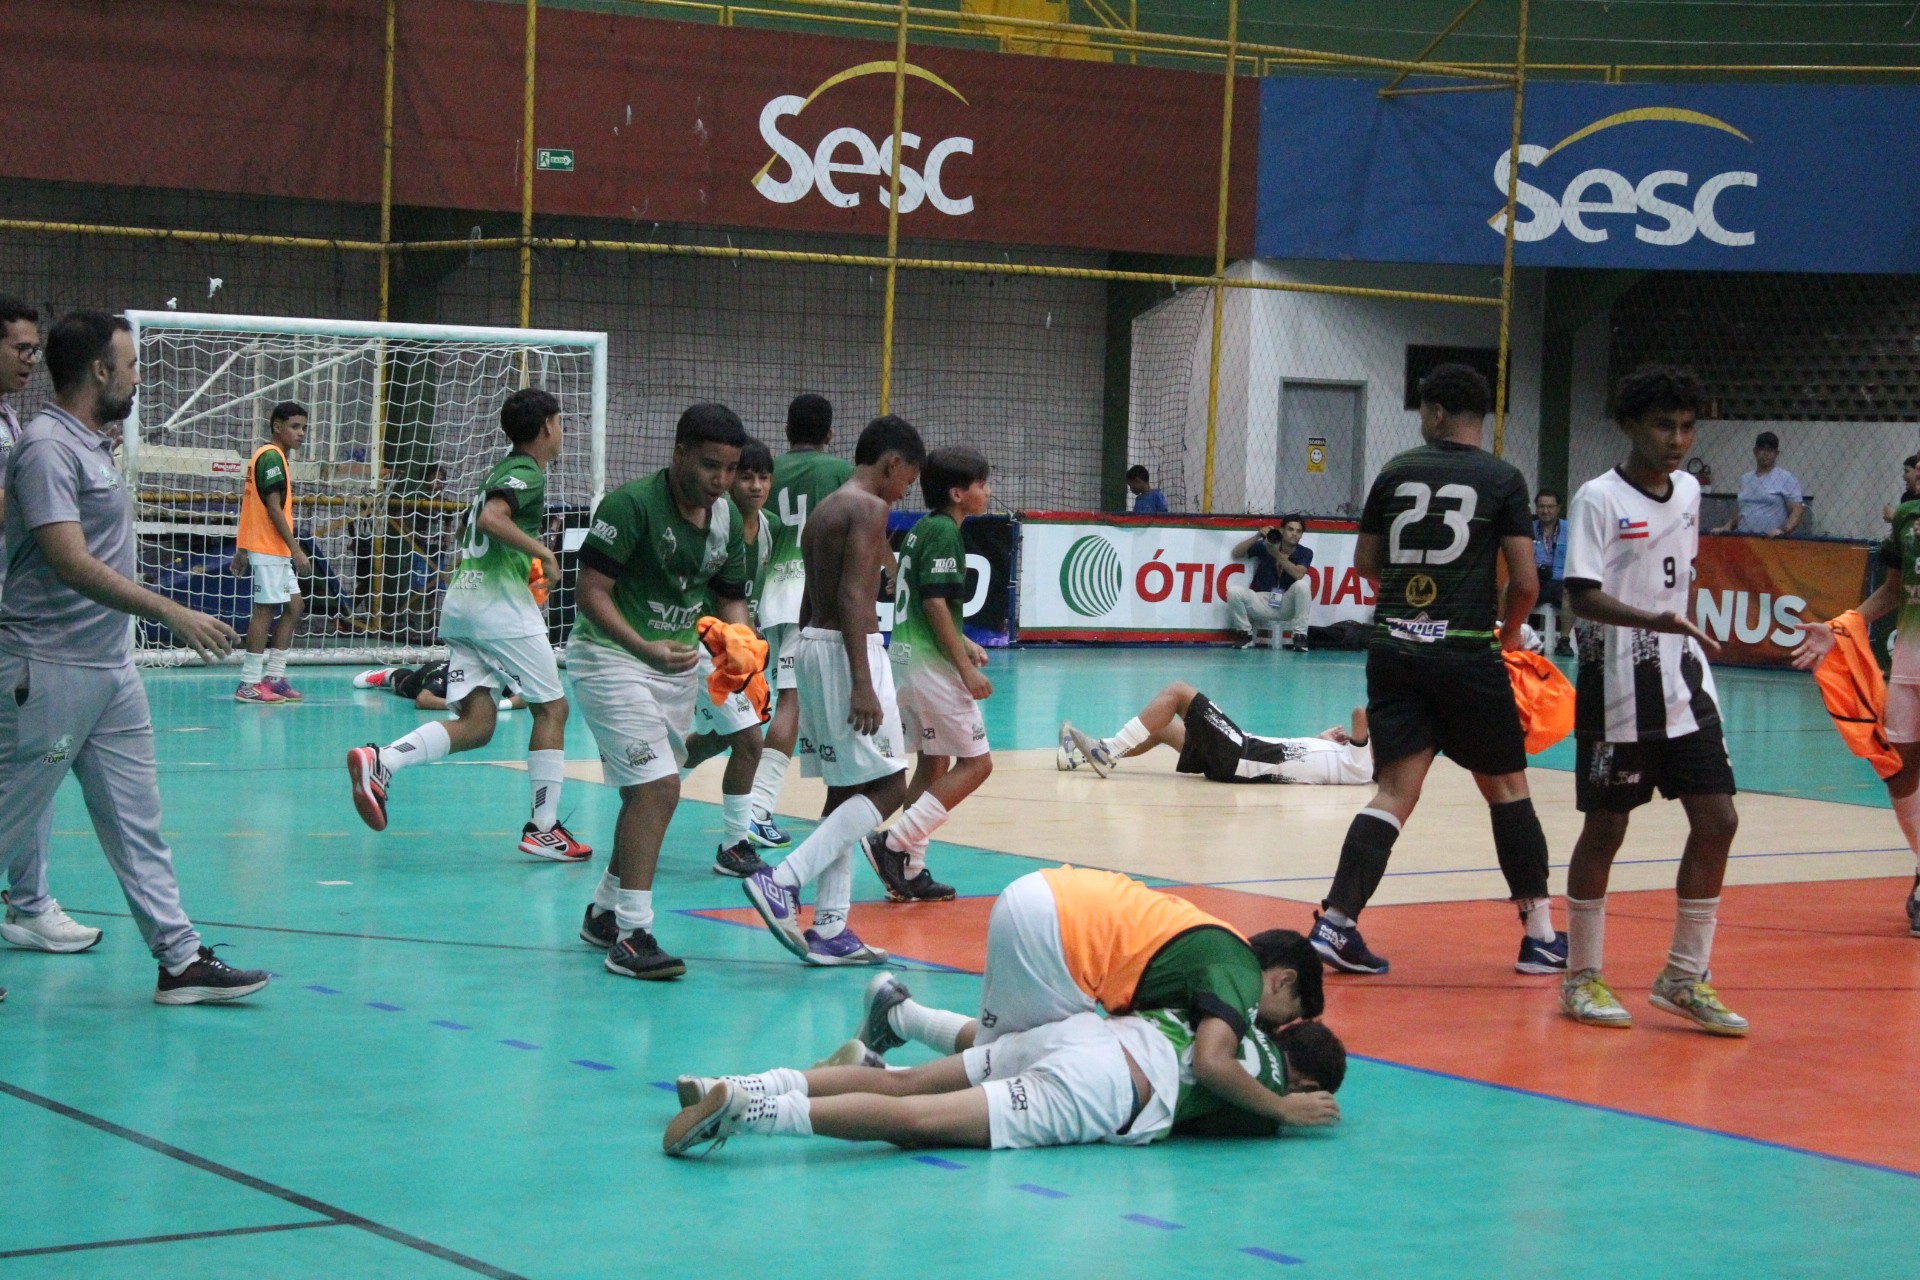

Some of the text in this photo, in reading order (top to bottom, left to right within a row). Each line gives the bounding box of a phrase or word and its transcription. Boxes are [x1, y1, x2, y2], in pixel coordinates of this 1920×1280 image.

[751, 94, 975, 215] Sesc
[1487, 144, 1758, 246] Sesc
[778, 486, 807, 547] 4
[1389, 482, 1478, 565] 23
[1136, 549, 1246, 603] ÓTIC
[1663, 556, 1676, 588] 9
